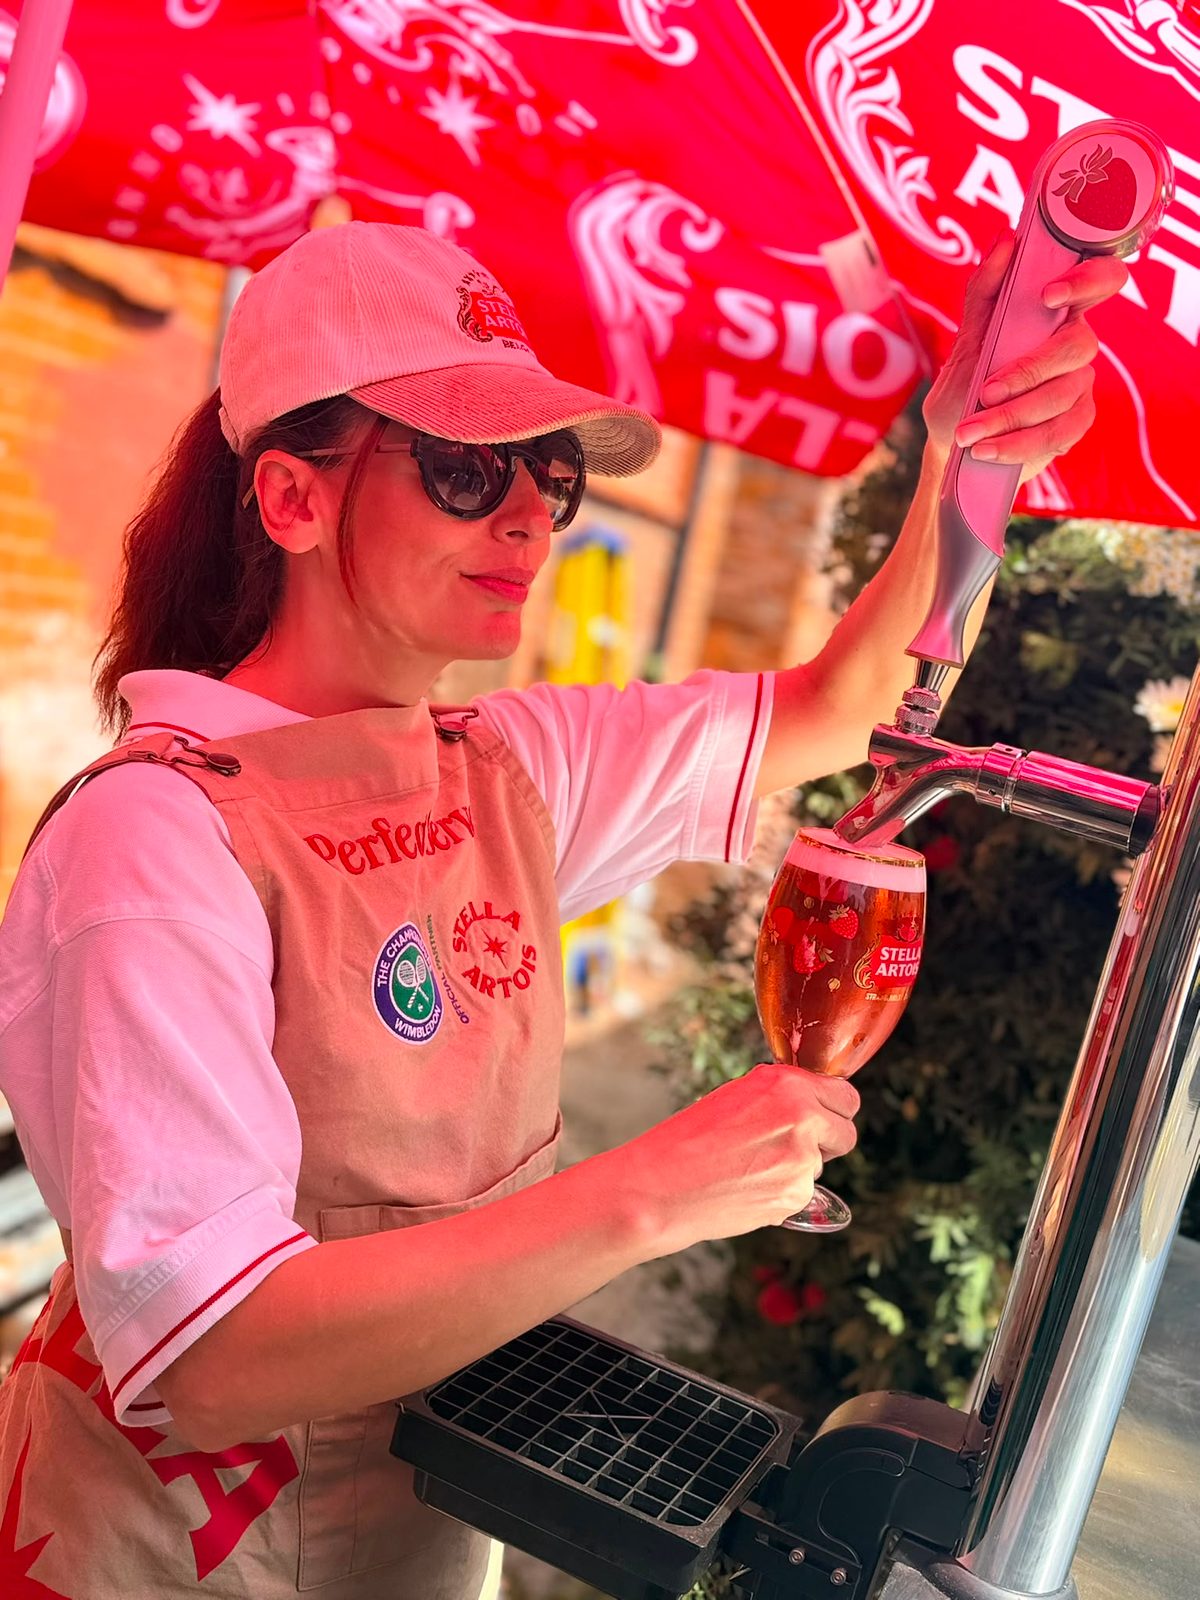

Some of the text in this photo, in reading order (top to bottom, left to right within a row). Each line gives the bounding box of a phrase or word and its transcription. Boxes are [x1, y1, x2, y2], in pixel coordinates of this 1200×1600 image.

[453, 902, 520, 953] STELLA
[377, 960, 390, 987] THE
[461, 944, 536, 999] ARTOIS
[394, 1005, 441, 1038] WIMBLEDON
[441, 972, 469, 1024] OFFICIAL
